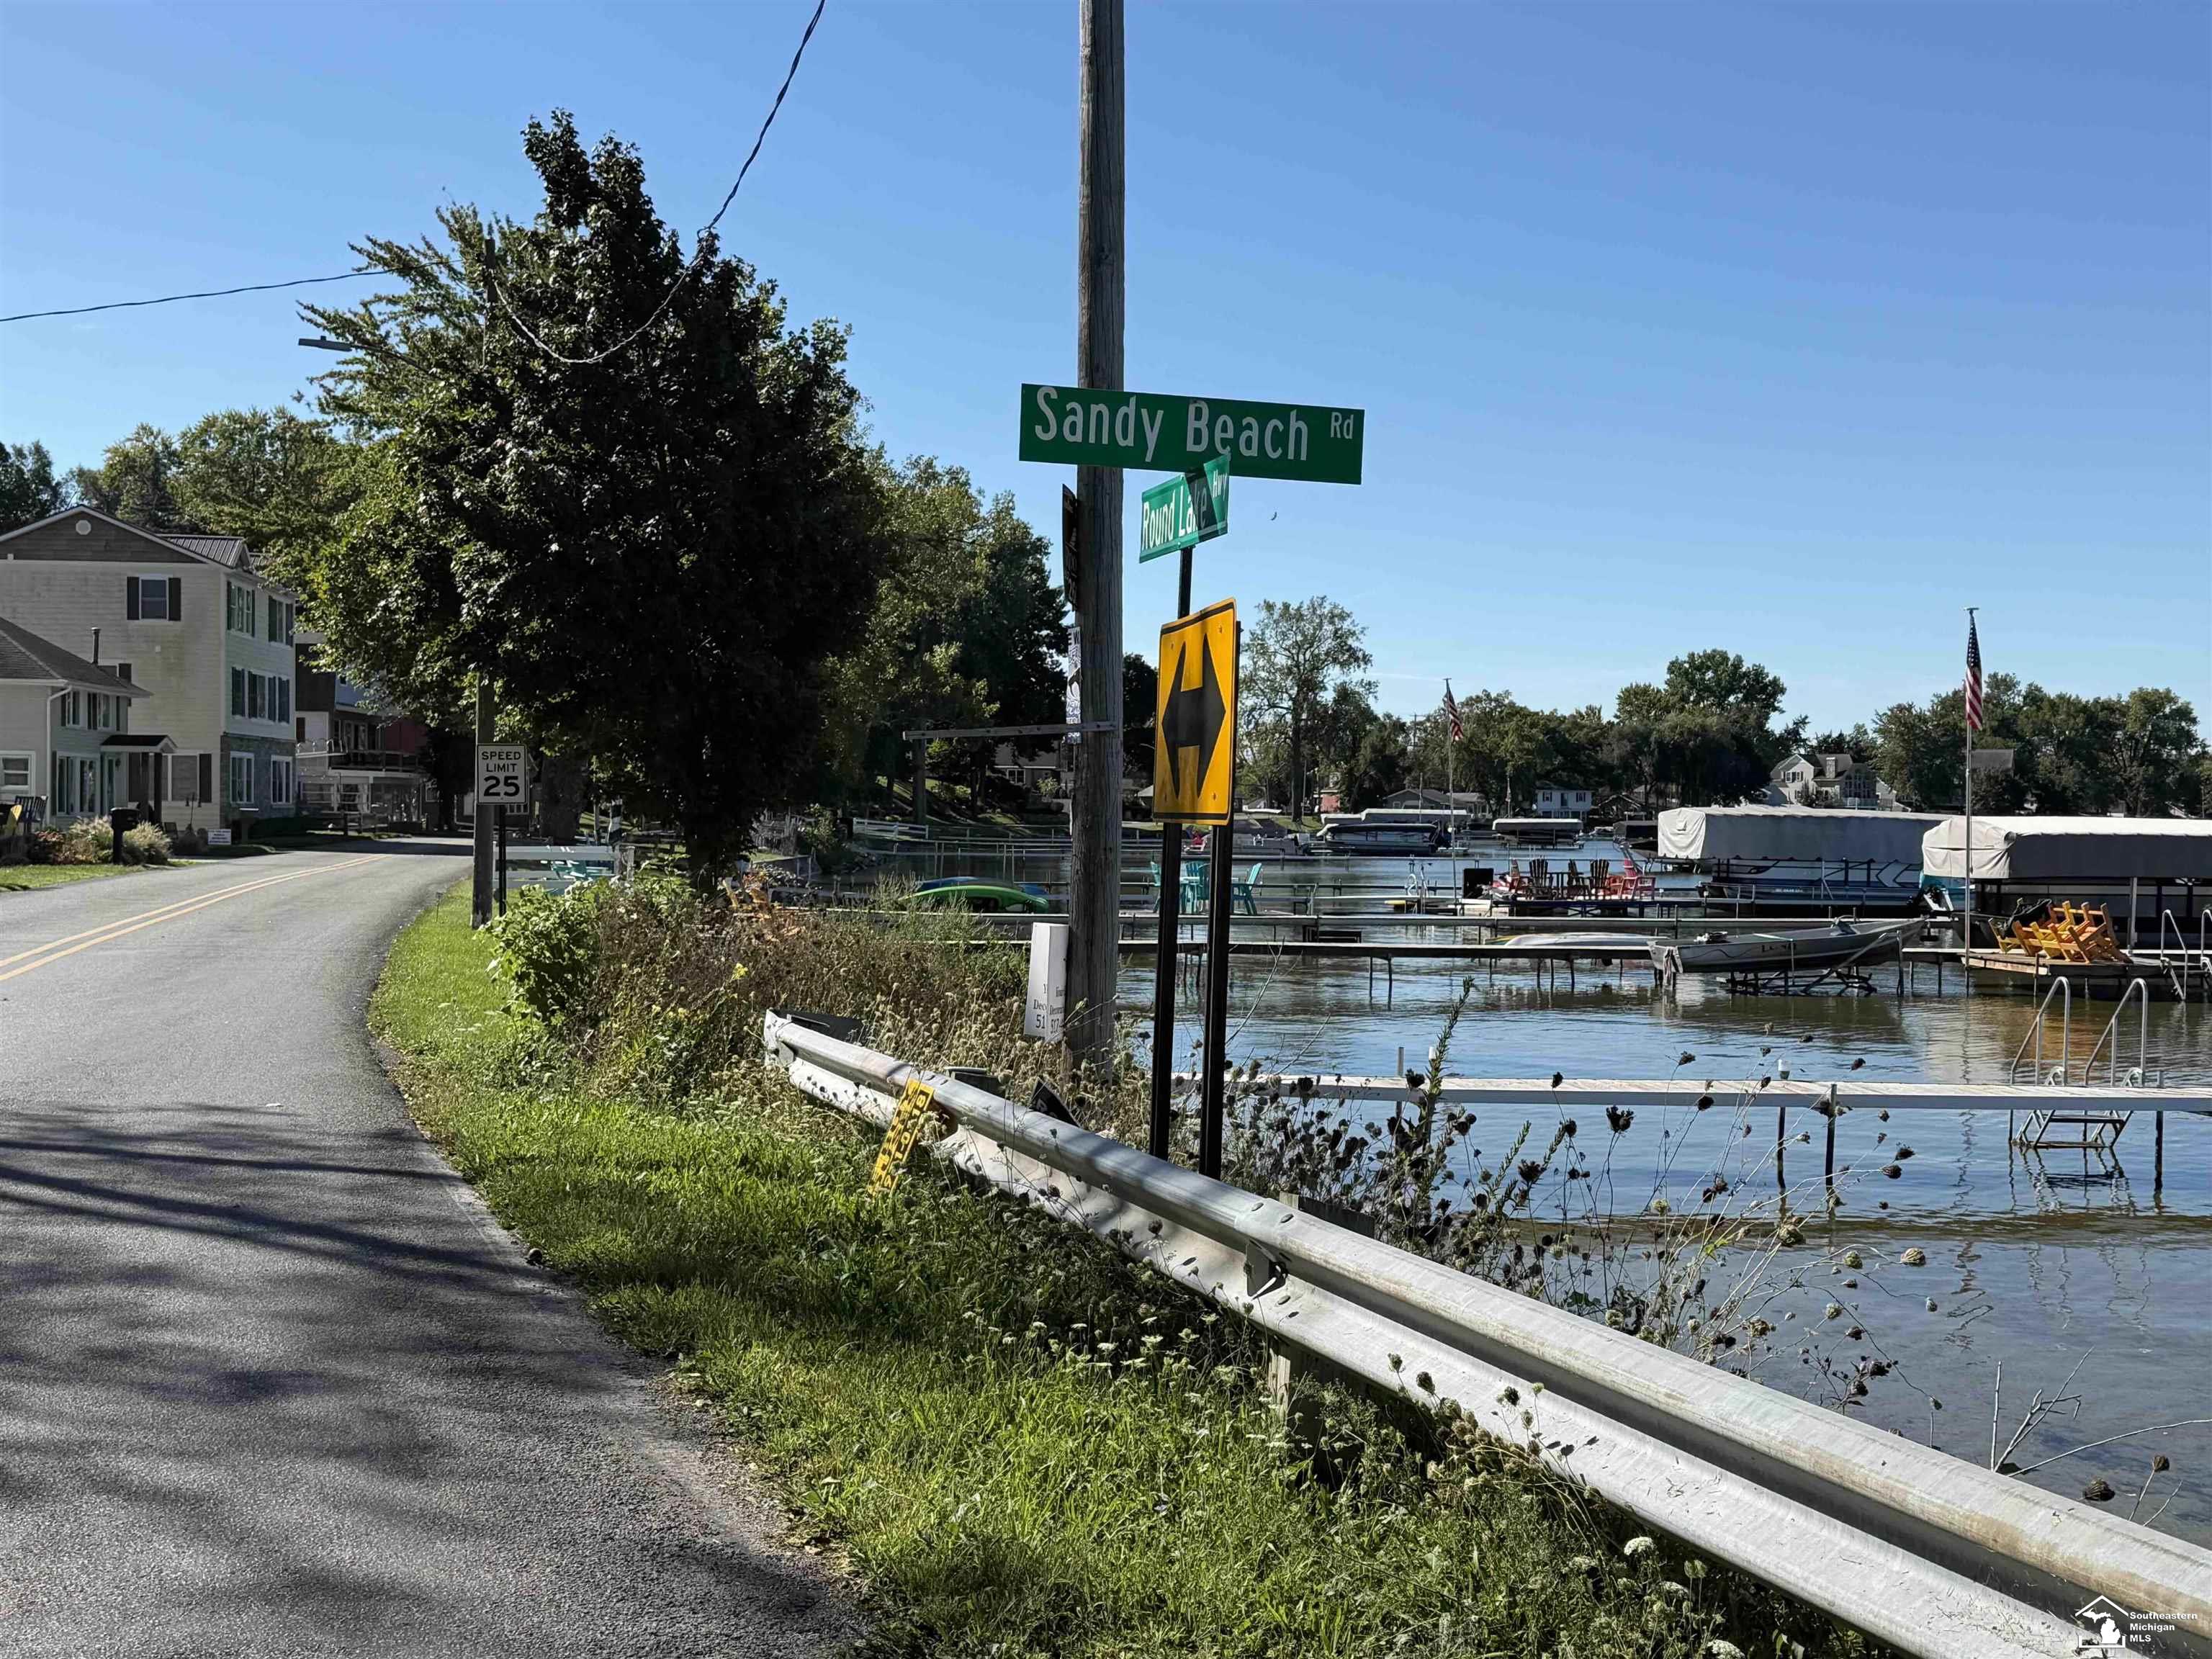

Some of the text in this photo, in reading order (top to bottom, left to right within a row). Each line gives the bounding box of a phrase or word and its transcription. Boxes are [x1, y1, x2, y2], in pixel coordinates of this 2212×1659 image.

[1035, 386, 1354, 462] Sandy Beach Rd
[1142, 469, 1228, 551] Round Lake Hwy
[481, 751, 521, 760] SPEED
[486, 763, 518, 773] LIMIT
[484, 775, 520, 797] 25
